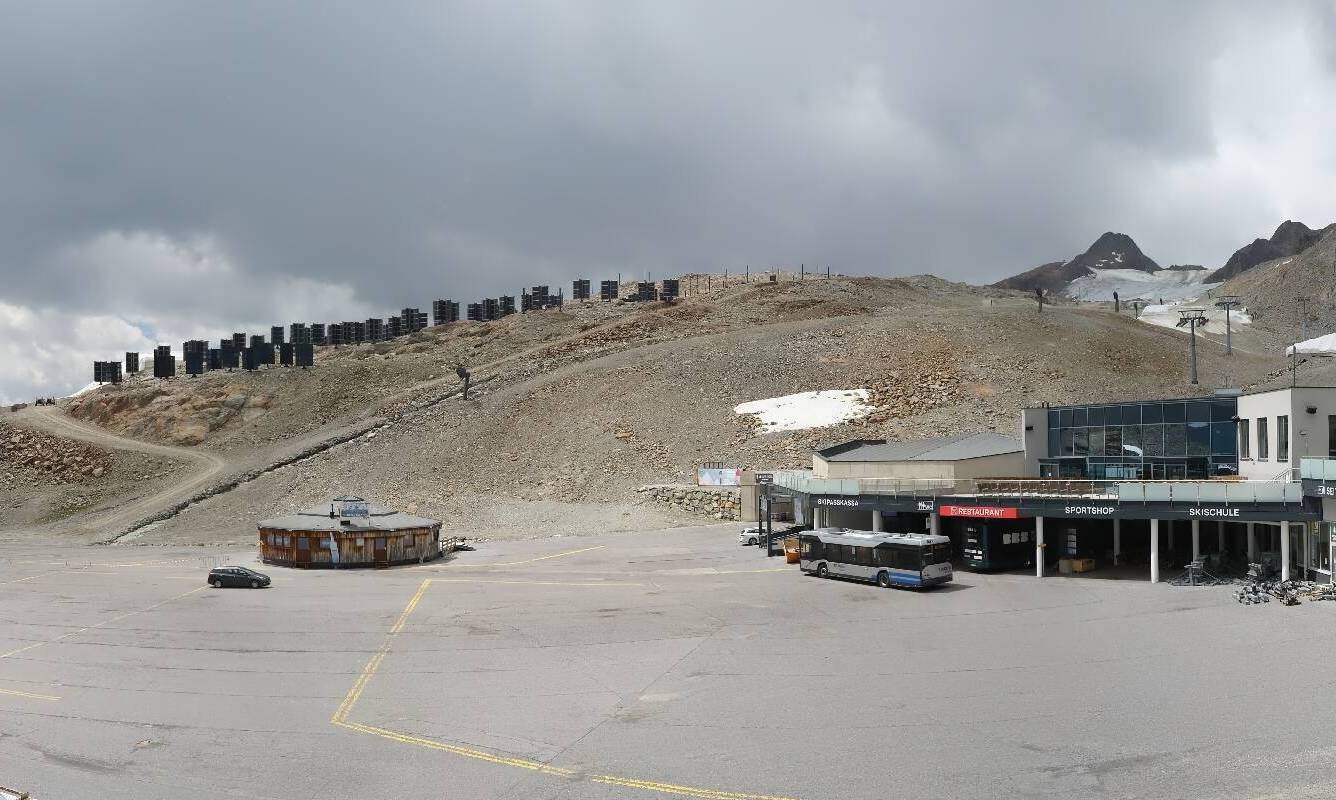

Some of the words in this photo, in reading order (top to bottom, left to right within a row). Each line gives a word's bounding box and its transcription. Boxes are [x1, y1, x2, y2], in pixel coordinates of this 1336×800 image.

[958, 508, 1005, 517] RESTAURANT
[1065, 506, 1115, 515] SPORTSHOP
[1189, 508, 1240, 517] SKISCHULE
